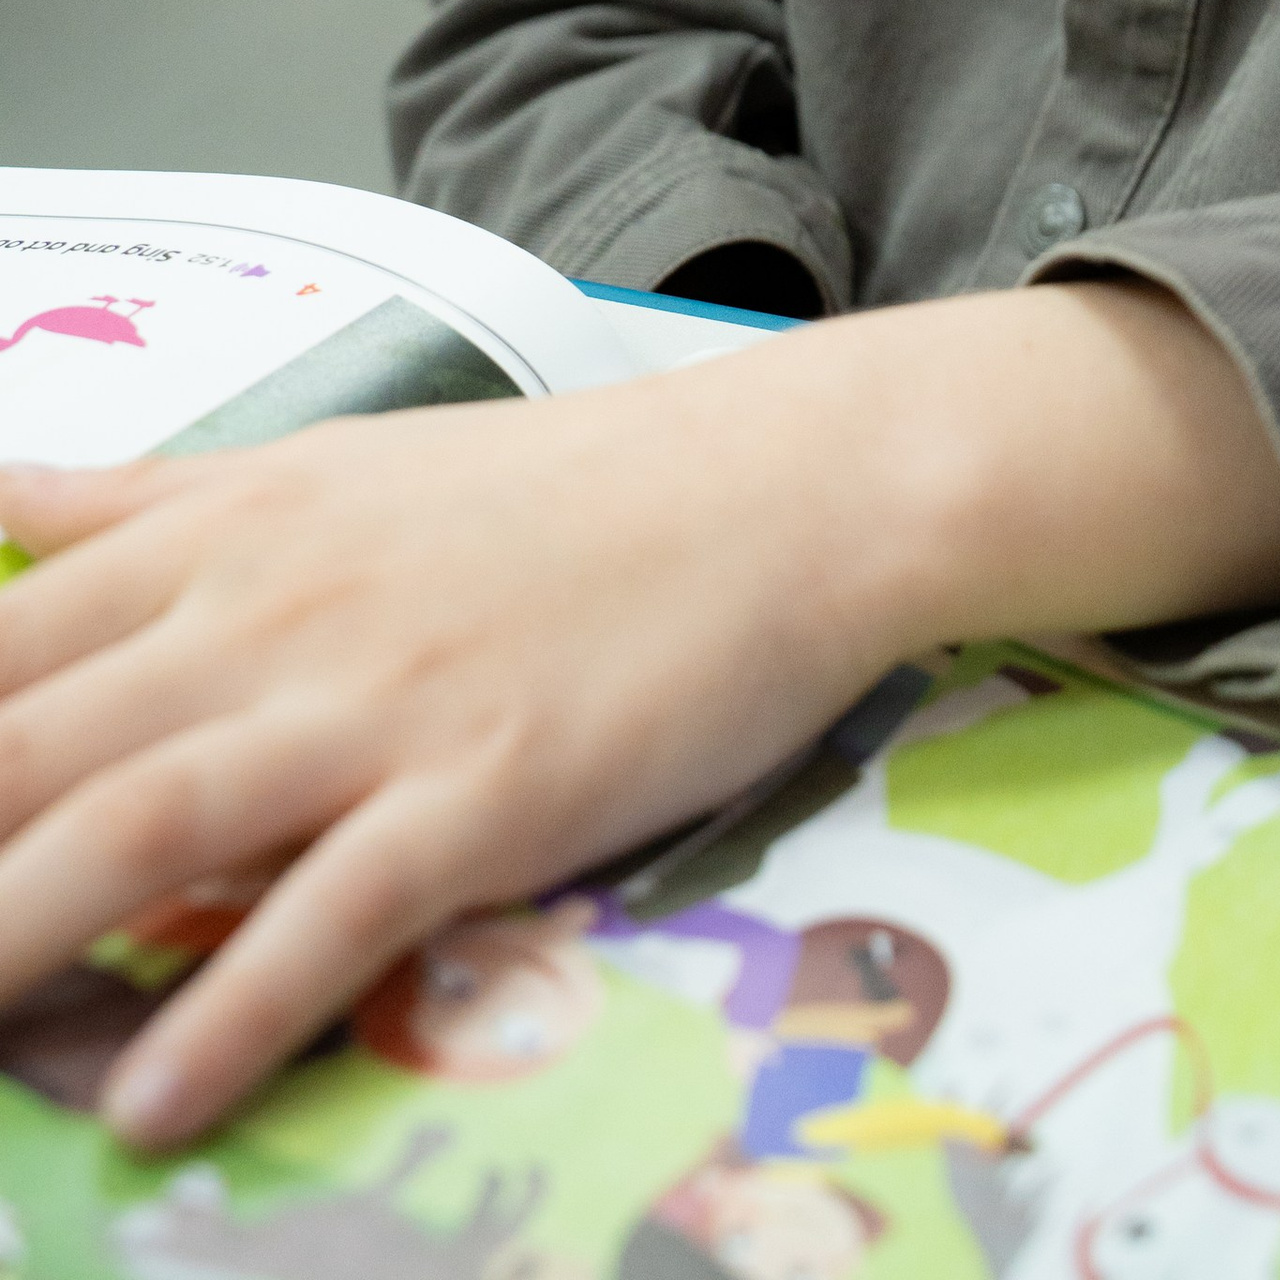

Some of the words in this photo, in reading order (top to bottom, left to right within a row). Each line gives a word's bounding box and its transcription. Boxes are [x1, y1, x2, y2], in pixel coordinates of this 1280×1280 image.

[20, 240, 68, 252] act
[60, 242, 120, 255] and
[121, 243, 182, 262] Sing
[187, 253, 233, 268] 1.52
[295, 283, 322, 297] 4
